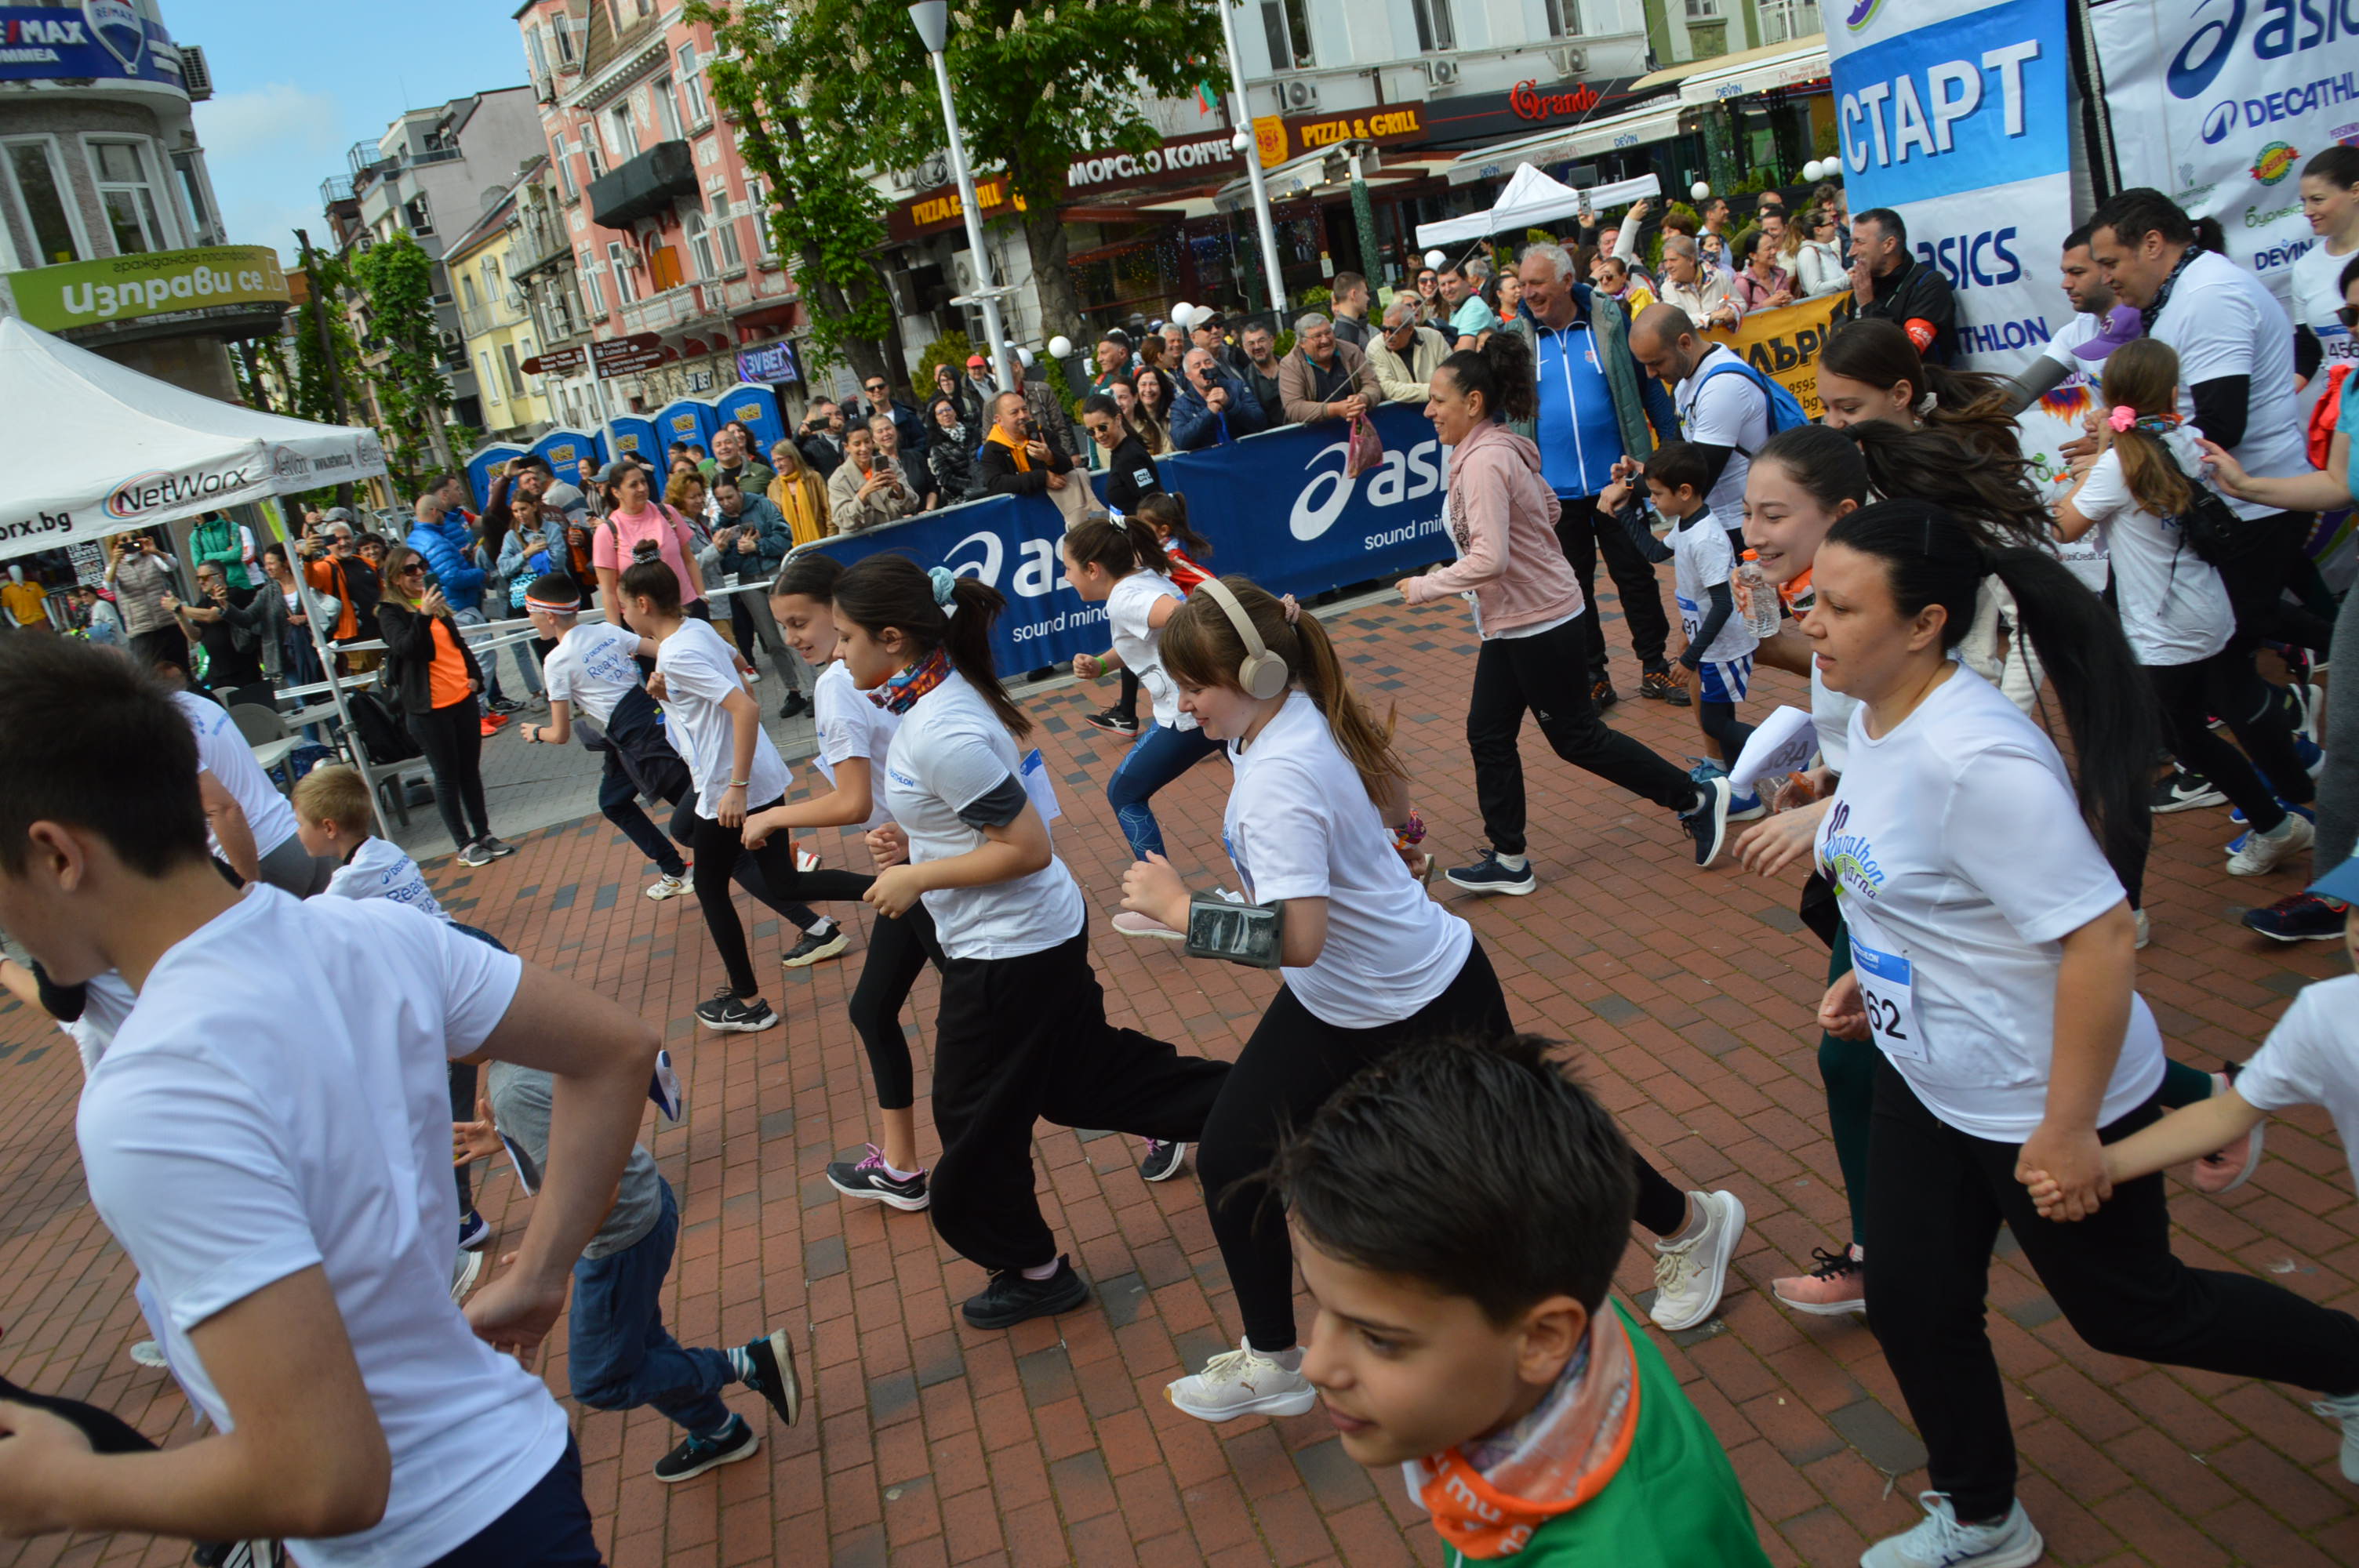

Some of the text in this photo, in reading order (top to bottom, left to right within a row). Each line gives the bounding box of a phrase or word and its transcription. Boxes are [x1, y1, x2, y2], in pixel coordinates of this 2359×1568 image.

[1509, 78, 1601, 121] Grande
[1715, 83, 1743, 98] DEVIN
[1841, 38, 2042, 174] СТАРТ
[1300, 109, 1419, 147] PIZZA & GRILL
[1166, 138, 1234, 170] КОНЧЕ
[911, 197, 952, 227] PIZZA
[61, 265, 233, 317] Изправи
[1955, 316, 2052, 355] THLON
[118, 467, 249, 510] NetWorx
[1364, 519, 1416, 550] sound
[1012, 612, 1065, 643] sound
[1682, 617, 1698, 637] 91
[587, 653, 620, 680] Ready
[1859, 982, 1908, 1041] 62
